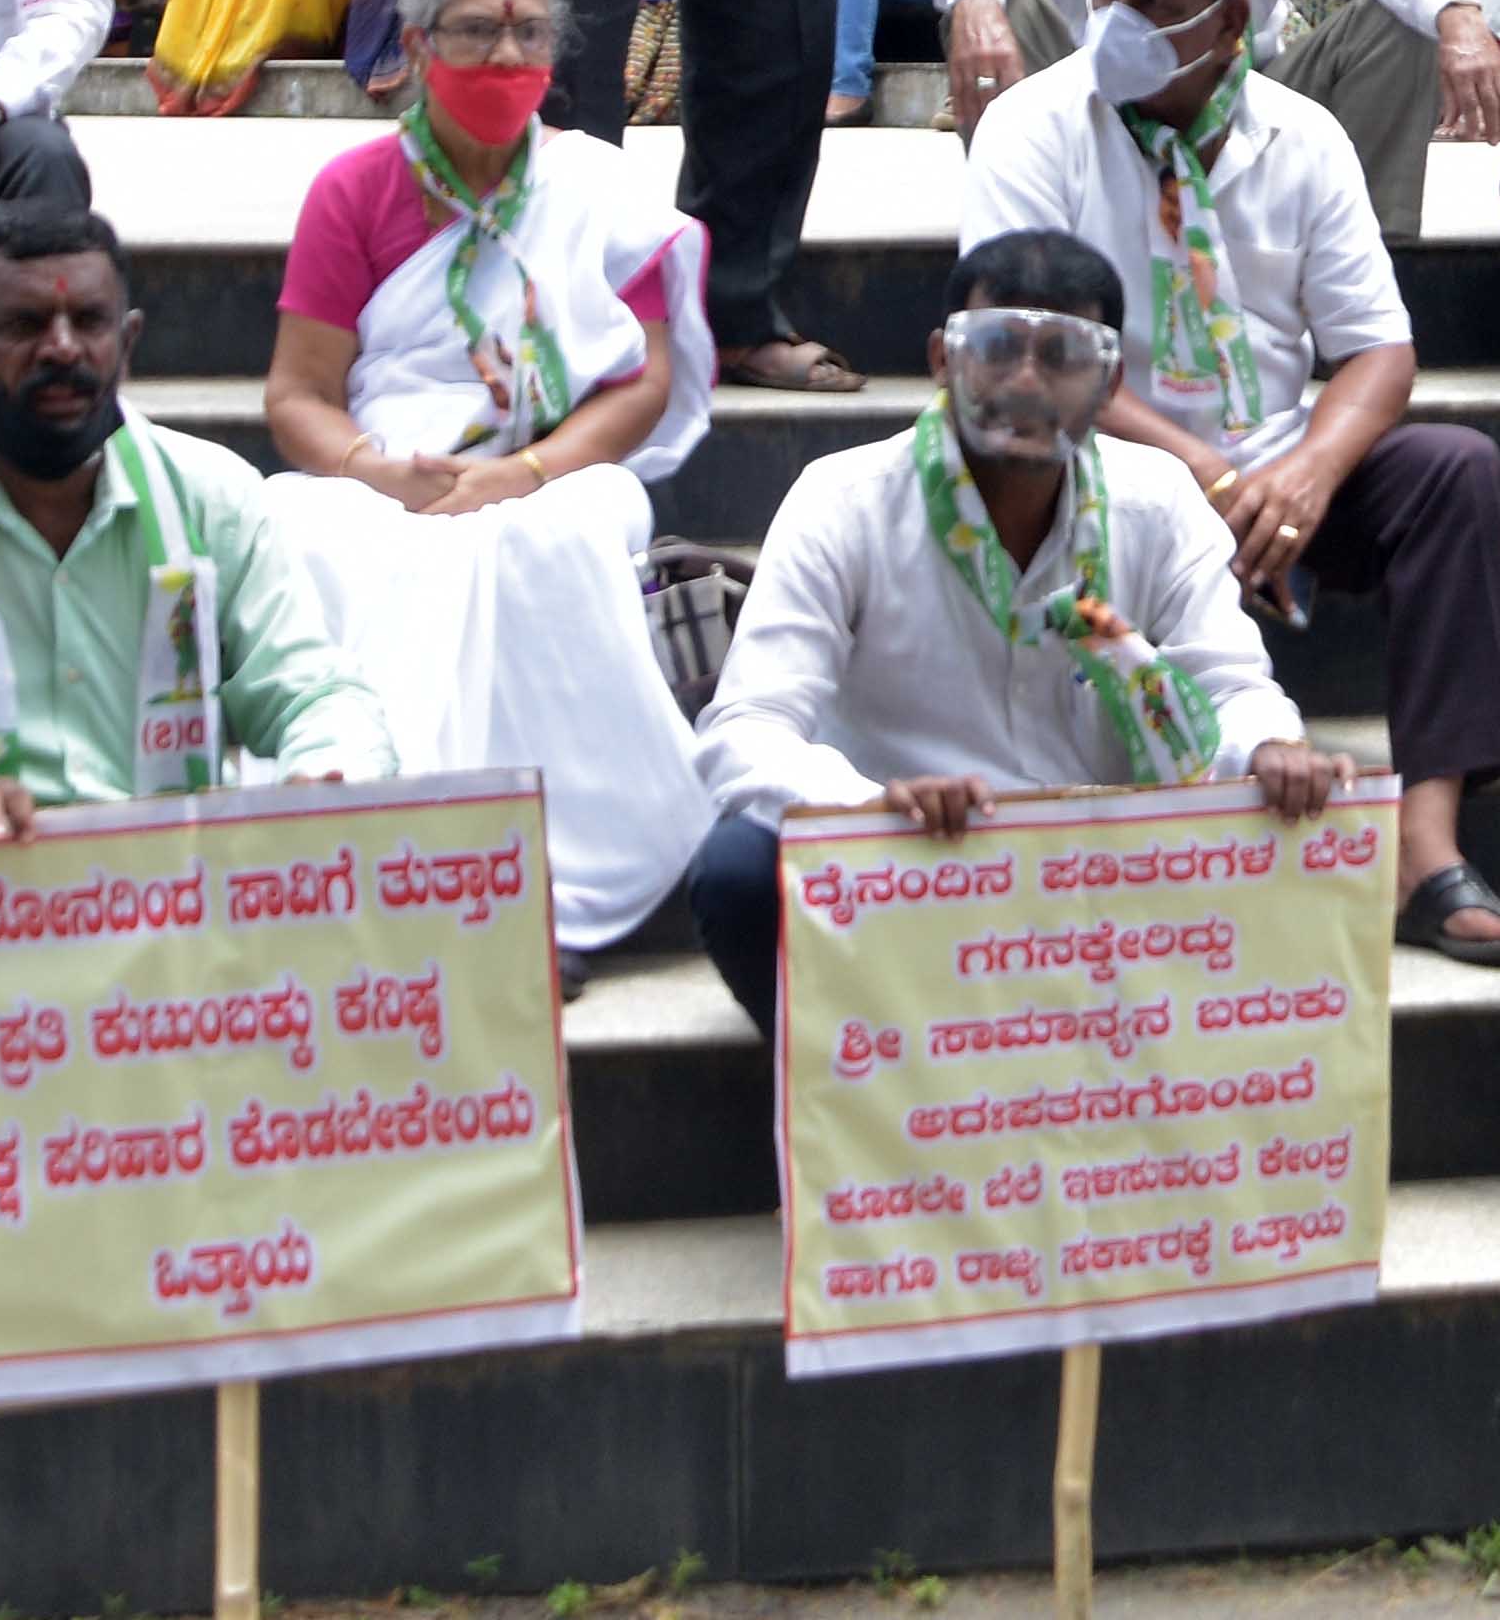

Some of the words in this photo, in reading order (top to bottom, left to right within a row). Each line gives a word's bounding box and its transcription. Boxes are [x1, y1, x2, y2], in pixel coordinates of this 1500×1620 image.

[228, 849, 357, 924] ಸಾವಿಗೆ
[379, 843, 524, 924] ತುತ್ತಾದ
[803, 858, 1013, 929] ದೈನಂದಿನ
[1041, 840, 1276, 892] ಪಡಿತರಗಳ
[1302, 828, 1379, 872] ಬೆಲೆ
[837, 1023, 901, 1080] ಶ್ರೀ
[931, 1002, 1172, 1060] ಸಾಮಾನ್ಯನ
[1197, 983, 1347, 1032] ಬದುಕು
[44, 1118, 206, 1188] ಪರಿಹಾರ
[827, 1175, 965, 1224] ಕೂಡಲೇ
[984, 1164, 1043, 1209] ಬೆಲೆ
[1258, 1138, 1349, 1181] ಕೇಂದ್ರ
[152, 1220, 312, 1316] ಒತ್ತಾಯ
[827, 1259, 937, 1299] ಹಾಗೂ
[958, 1250, 1042, 1298] ರಾಜ್ಯ
[1062, 1219, 1213, 1277] ಸರ್ಕಾರಕ್ಕೆ
[1230, 1208, 1345, 1261] ಒತ್ತಾಯ
